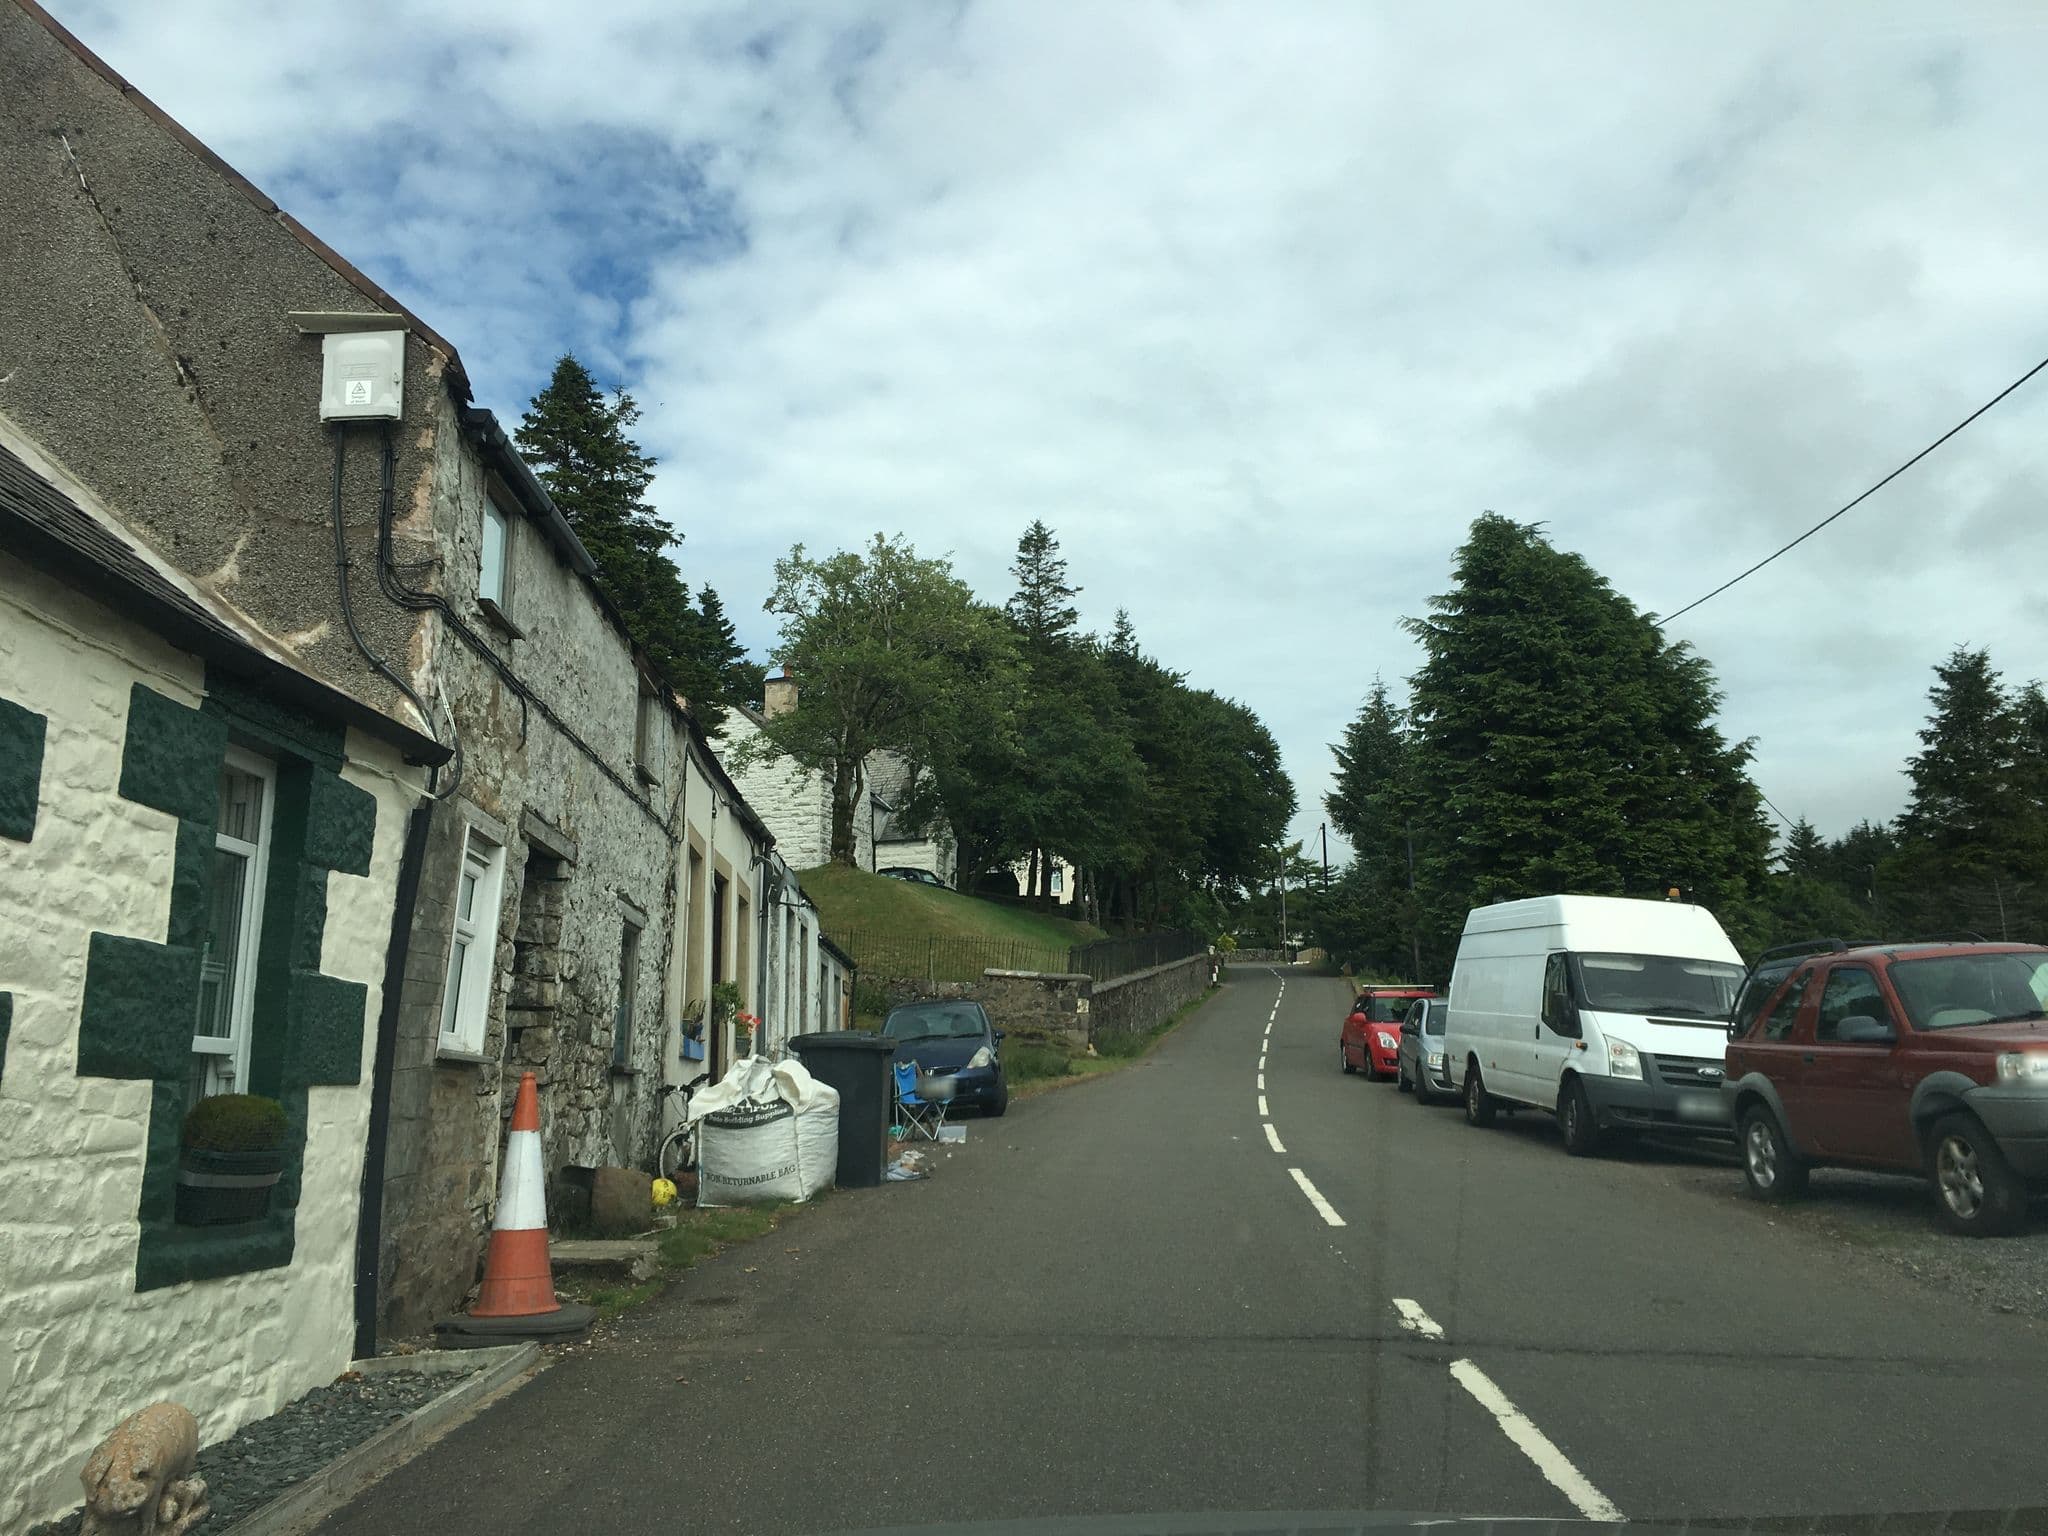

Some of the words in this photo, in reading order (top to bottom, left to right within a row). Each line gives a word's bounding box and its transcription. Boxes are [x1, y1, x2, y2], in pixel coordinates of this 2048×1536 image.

[755, 1107, 787, 1121] Supplies
[722, 1171, 776, 1185] RETURNABLE
[778, 1164, 796, 1178] BAG
